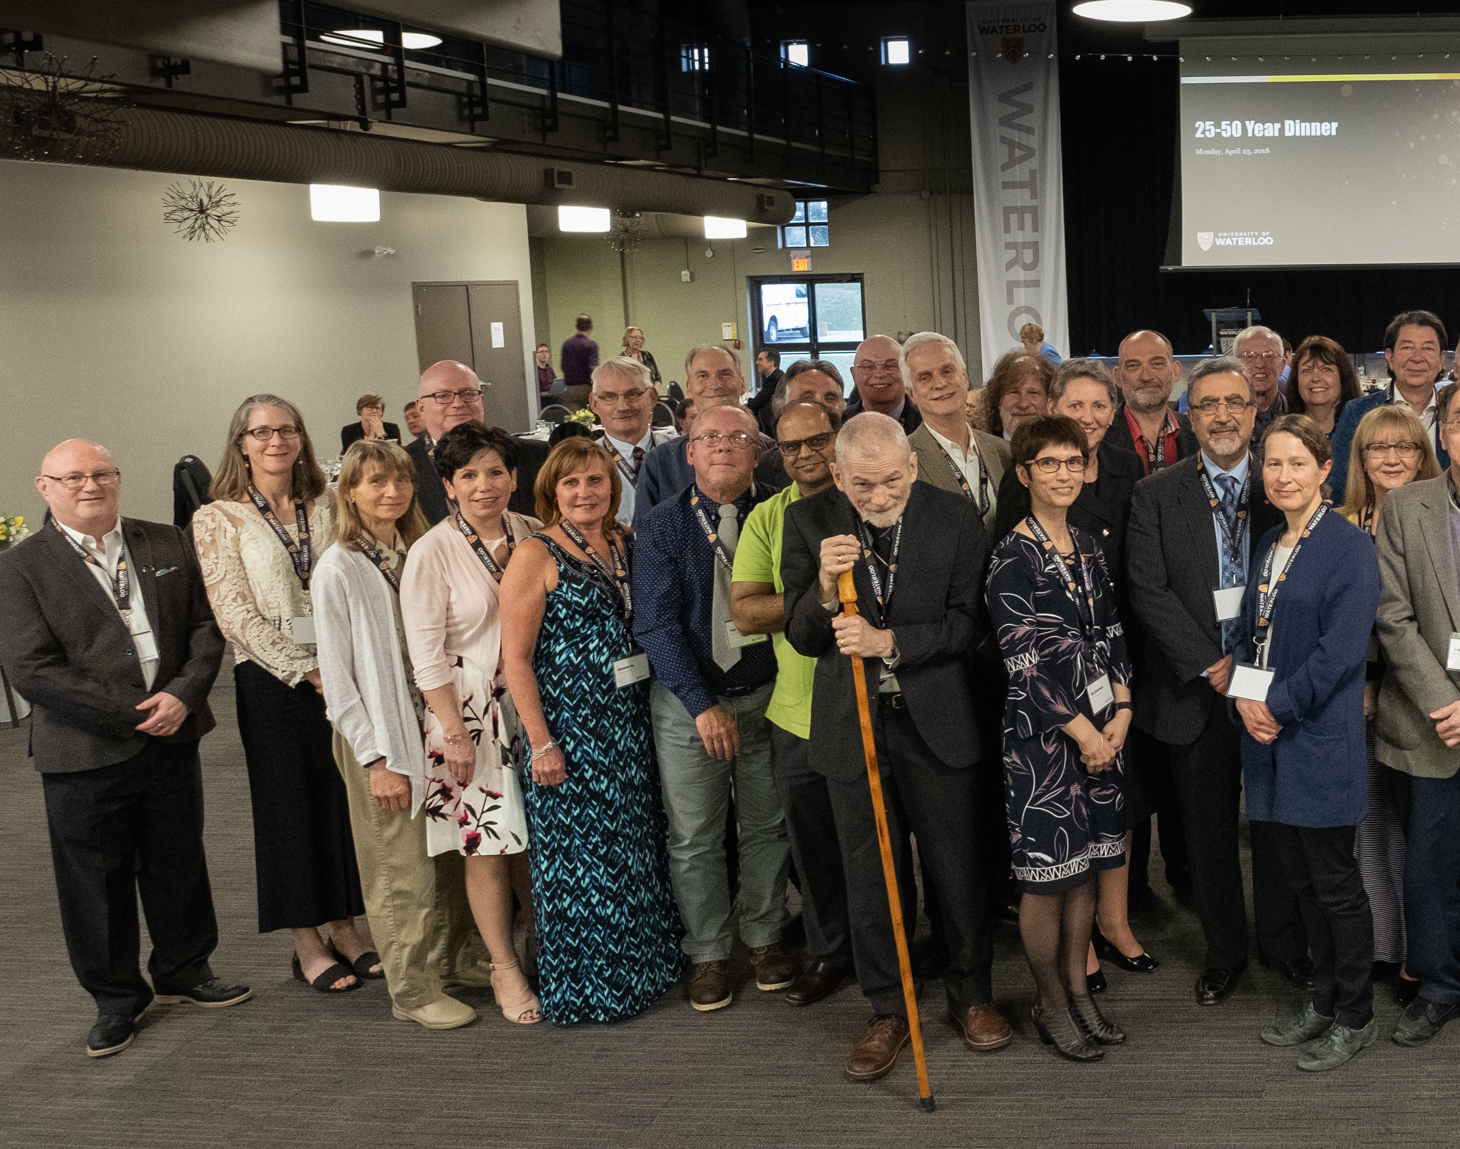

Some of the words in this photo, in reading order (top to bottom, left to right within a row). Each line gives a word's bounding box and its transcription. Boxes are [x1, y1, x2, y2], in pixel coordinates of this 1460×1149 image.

[979, 23, 1046, 35] WATERLOO
[1195, 120, 1242, 138] 25-50
[1245, 120, 1281, 137] Year
[1284, 119, 1339, 137] Dinner
[1195, 148, 1224, 156] Monday,
[1224, 147, 1241, 155] April
[998, 81, 1043, 346] WATERLO
[1215, 236, 1274, 246] WATERLOO
[793, 258, 808, 271] EXIT
[1200, 473, 1216, 498] WATERLOO
[269, 517, 288, 541] WATERLOO
[697, 508, 713, 534] WATERLOO
[1027, 516, 1048, 541] WATERLOO
[1308, 504, 1328, 531] WATERLOO
[561, 521, 582, 543] WATERLOO
[355, 537, 376, 558] ATERLOO
[477, 546, 497, 572] WATERLOO
[1282, 544, 1301, 573] WATERLOO
[868, 564, 883, 595] WATERLOO
[1053, 553, 1072, 582] WATERLOO
[1263, 587, 1278, 618] WATERLOO
